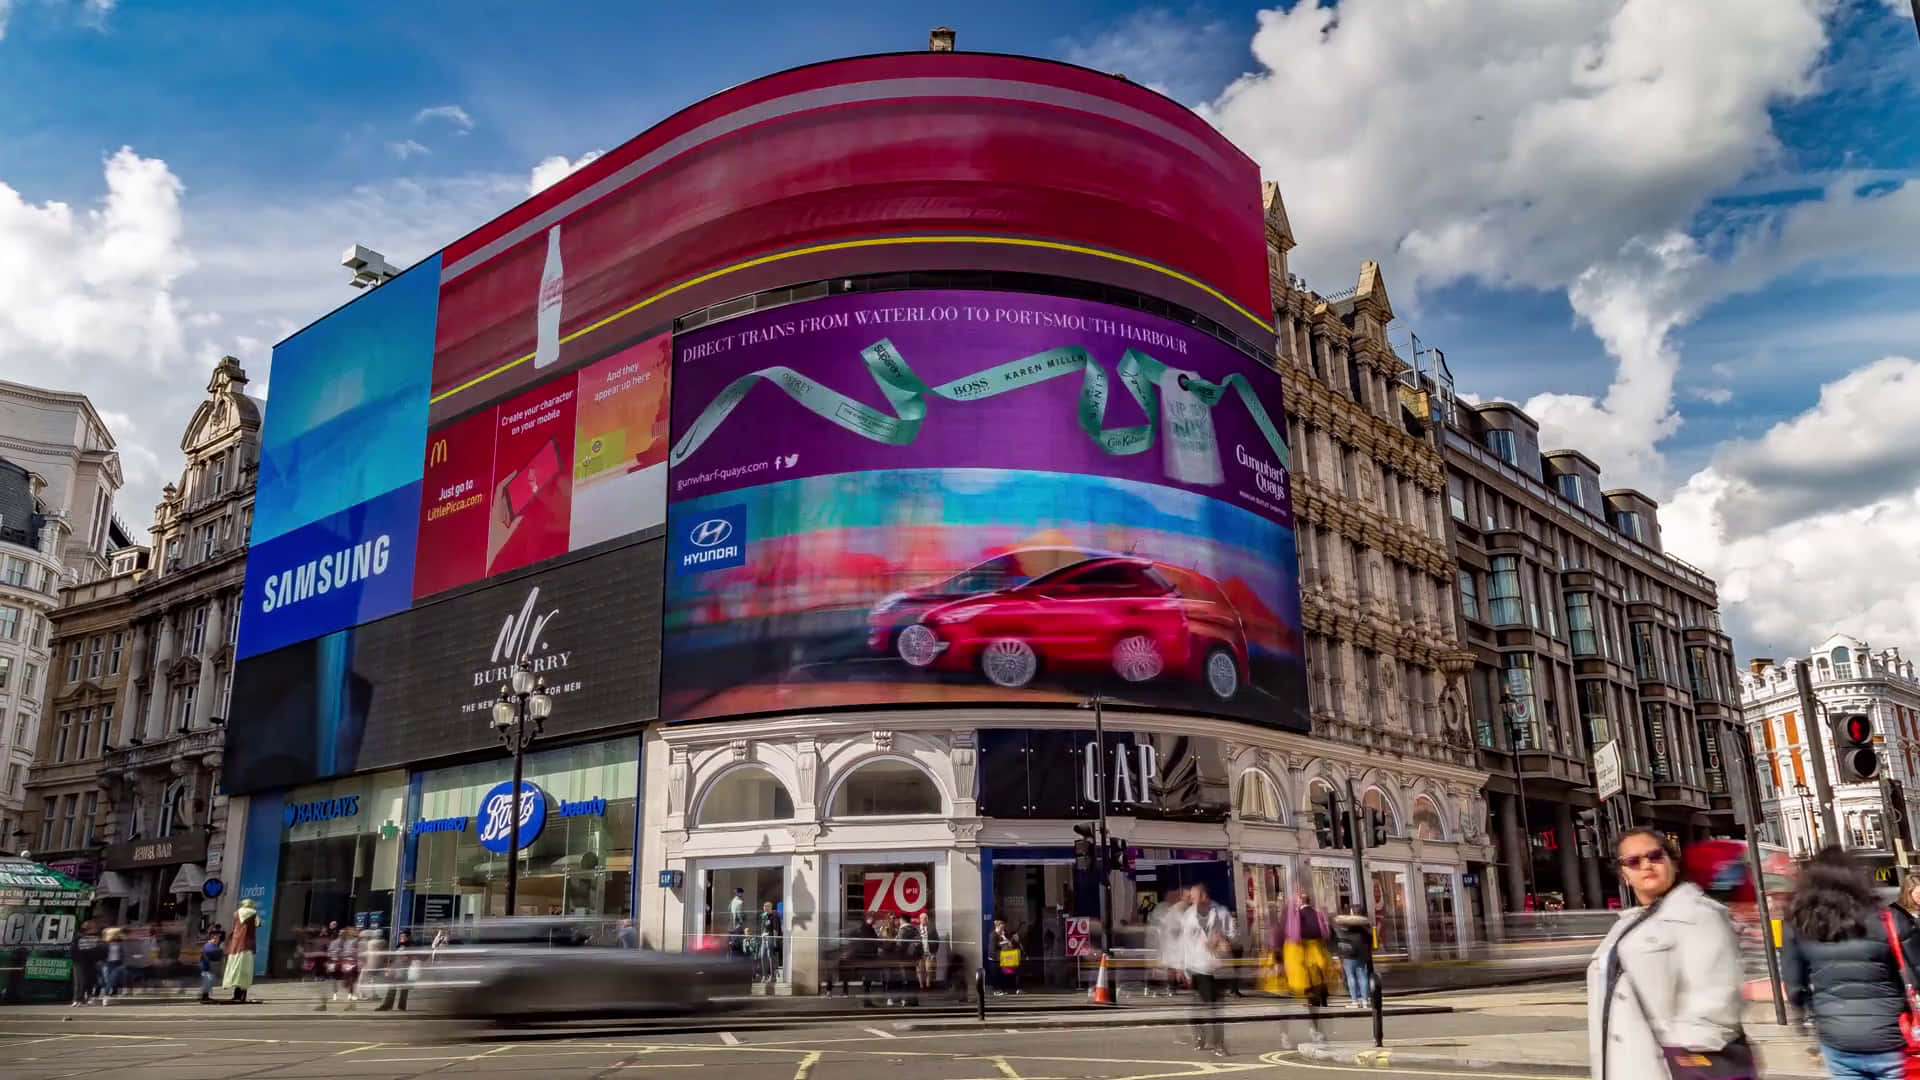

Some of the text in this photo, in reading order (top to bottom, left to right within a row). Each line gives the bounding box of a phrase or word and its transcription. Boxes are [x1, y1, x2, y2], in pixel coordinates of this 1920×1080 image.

[682, 306, 1188, 363] DIRECT TRAINS FROM WATERLOO TO PORTSMOUTH HARBOUR
[607, 361, 639, 383] And they
[953, 378, 989, 395] BOSS
[1004, 363, 1042, 381] KAREN
[595, 385, 620, 402] appear
[632, 372, 651, 387] here
[501, 389, 574, 426] Create your character
[511, 409, 561, 435] on your mobile
[677, 460, 769, 491] gunwharf-quays.com
[1236, 444, 1286, 485] Gunwharf
[438, 479, 474, 501] Just go to
[1256, 471, 1286, 501] Quays
[683, 545, 738, 567] HYUNDAI
[262, 534, 390, 613] SAMSUNG
[491, 587, 559, 665] Mr.
[473, 651, 572, 687] BURBRRY
[462, 703, 476, 713] THE
[1084, 742, 1157, 804] GAP
[296, 795, 360, 824] BARCLAYS
[559, 796, 607, 819] beauty
[412, 816, 469, 836] pharmacy
[241, 884, 265, 898] London
[865, 872, 927, 912] 70
[1066, 917, 1089, 934] 70
